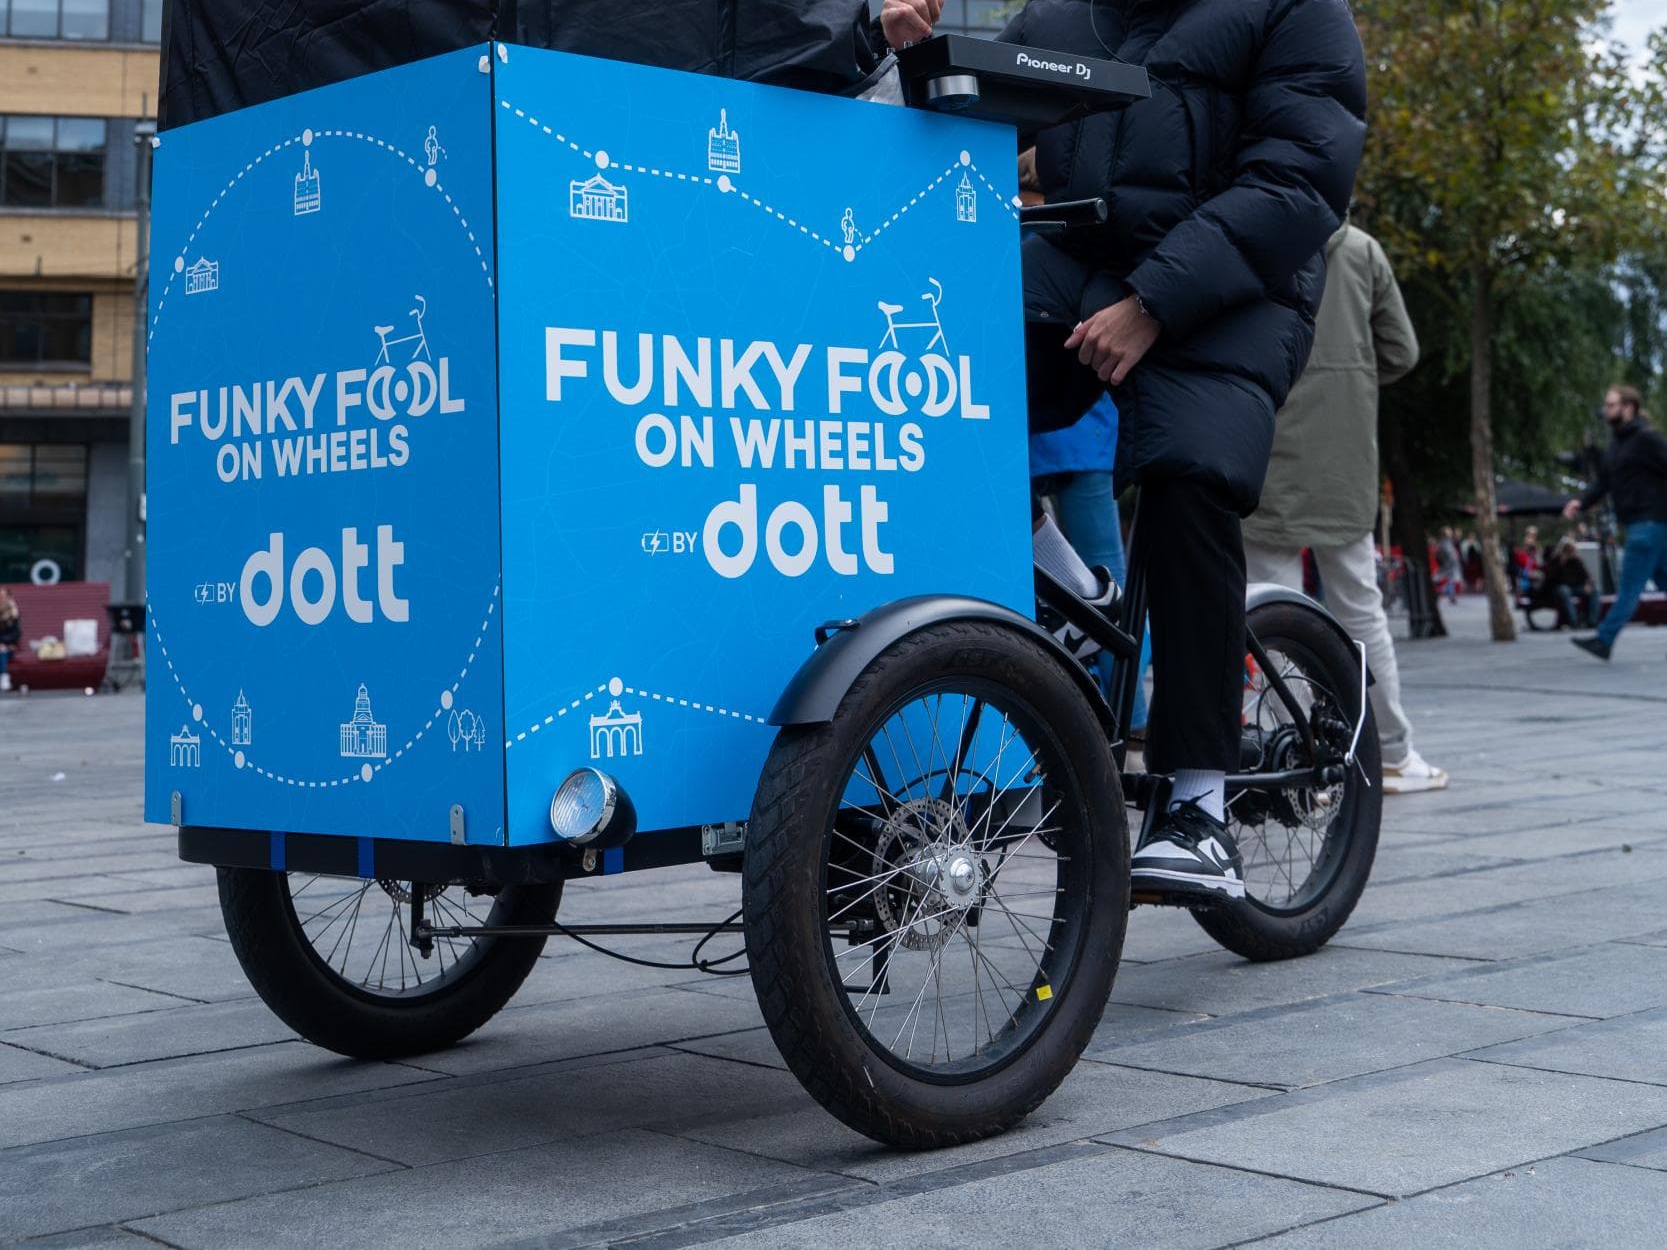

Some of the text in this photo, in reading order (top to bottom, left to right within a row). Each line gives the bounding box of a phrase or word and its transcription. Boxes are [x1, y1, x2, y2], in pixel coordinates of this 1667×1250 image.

[1016, 52, 1073, 74] Pioneer
[170, 356, 465, 445] FUNKY FOOL
[545, 326, 991, 420] FUNKY FOOL
[216, 424, 410, 483] ON WHEELS
[635, 413, 926, 472] ON WHEELS
[217, 524, 410, 627] BY dott
[672, 483, 895, 579] BY dott
